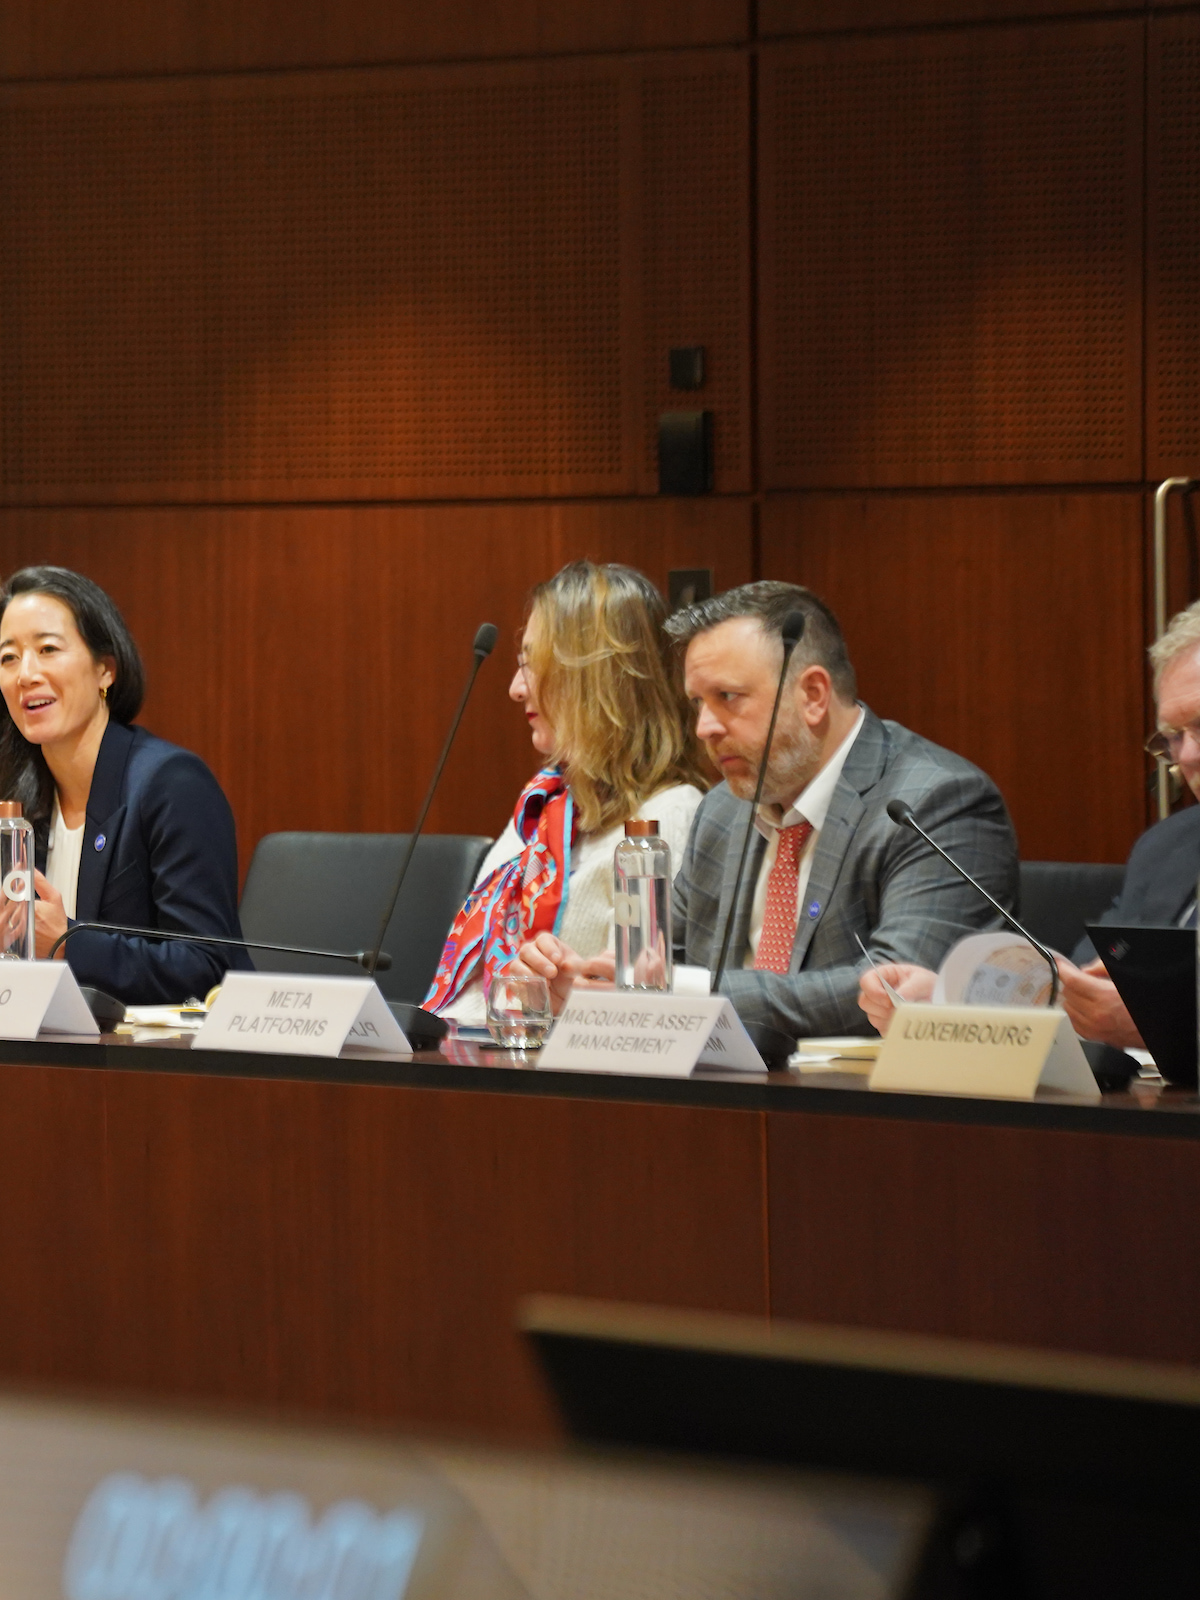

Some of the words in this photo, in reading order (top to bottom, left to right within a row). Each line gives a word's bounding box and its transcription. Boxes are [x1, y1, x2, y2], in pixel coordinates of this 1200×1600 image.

[266, 990, 313, 1010] META
[227, 1015, 329, 1038] PLATFORMS
[561, 1008, 654, 1029] MACQUARIE
[652, 1013, 708, 1033] ASSET
[902, 1018, 1033, 1047] LUXEMBOURG
[565, 1033, 677, 1056] MANAGEMENT
